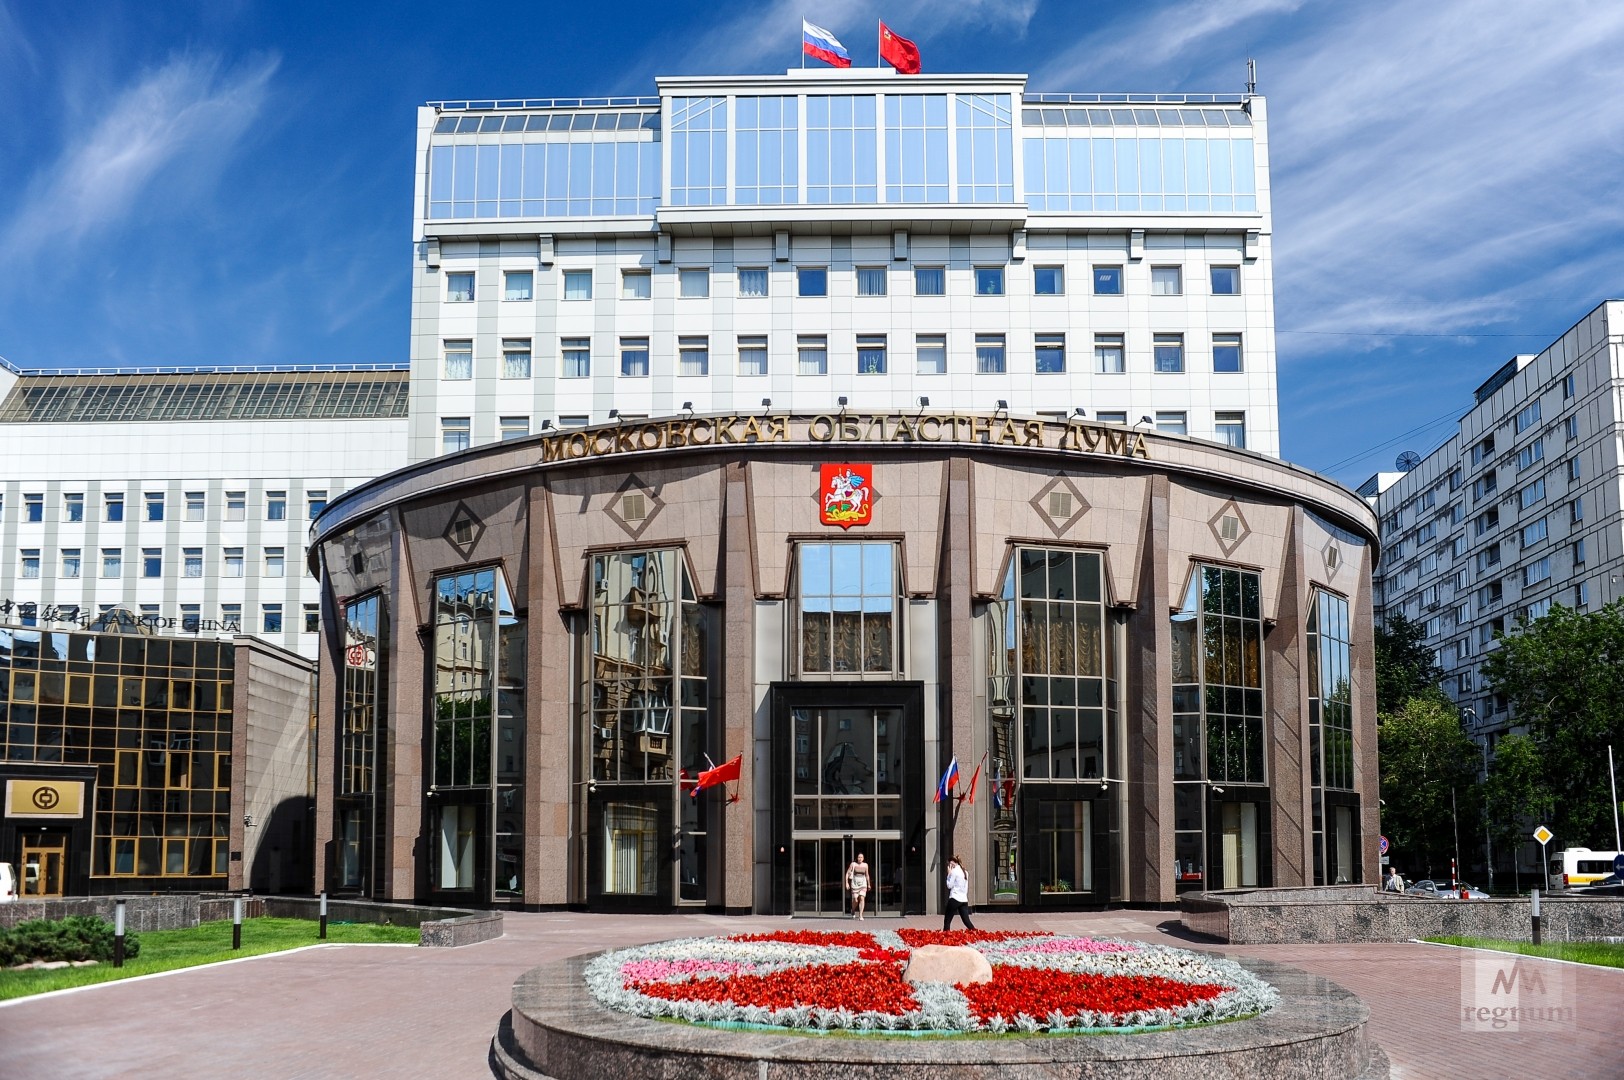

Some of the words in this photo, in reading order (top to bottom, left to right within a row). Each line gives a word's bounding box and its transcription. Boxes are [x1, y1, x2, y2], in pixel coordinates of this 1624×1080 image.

[542, 415, 790, 463] МОСКОВСКАЯ
[809, 415, 1044, 448] ОБЛАСТНАЯ
[1058, 424, 1151, 460] ДУМА
[98, 612, 152, 628] BANK
[154, 616, 177, 629] OF
[182, 618, 241, 632] CHINA
